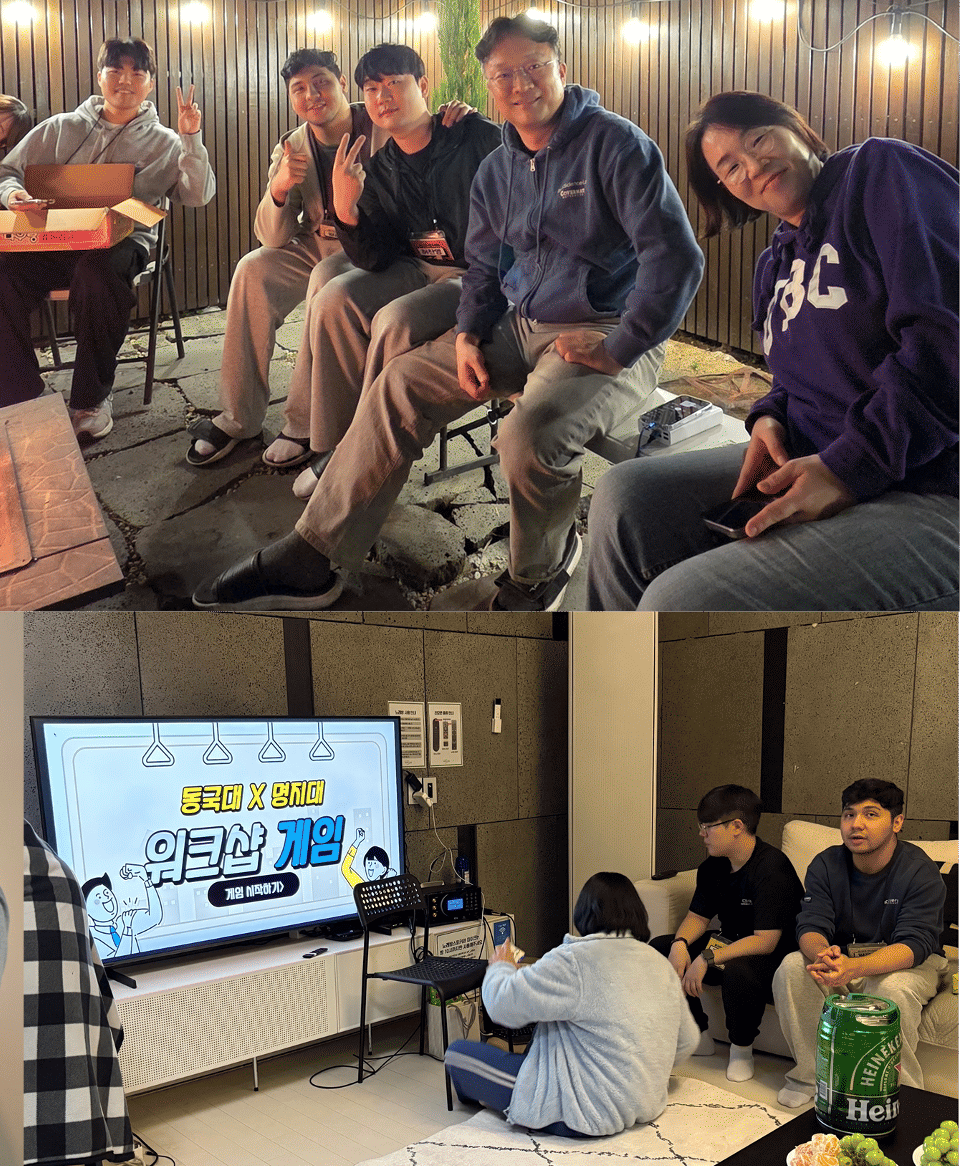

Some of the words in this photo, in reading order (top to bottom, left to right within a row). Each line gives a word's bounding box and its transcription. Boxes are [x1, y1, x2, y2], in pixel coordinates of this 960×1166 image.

[181, 783, 243, 815] 동국대
[247, 782, 267, 810] X
[271, 779, 325, 808] 명지대
[145, 822, 267, 887] 워크샵
[274, 815, 345, 870] 게임
[224, 887, 245, 901] 게임
